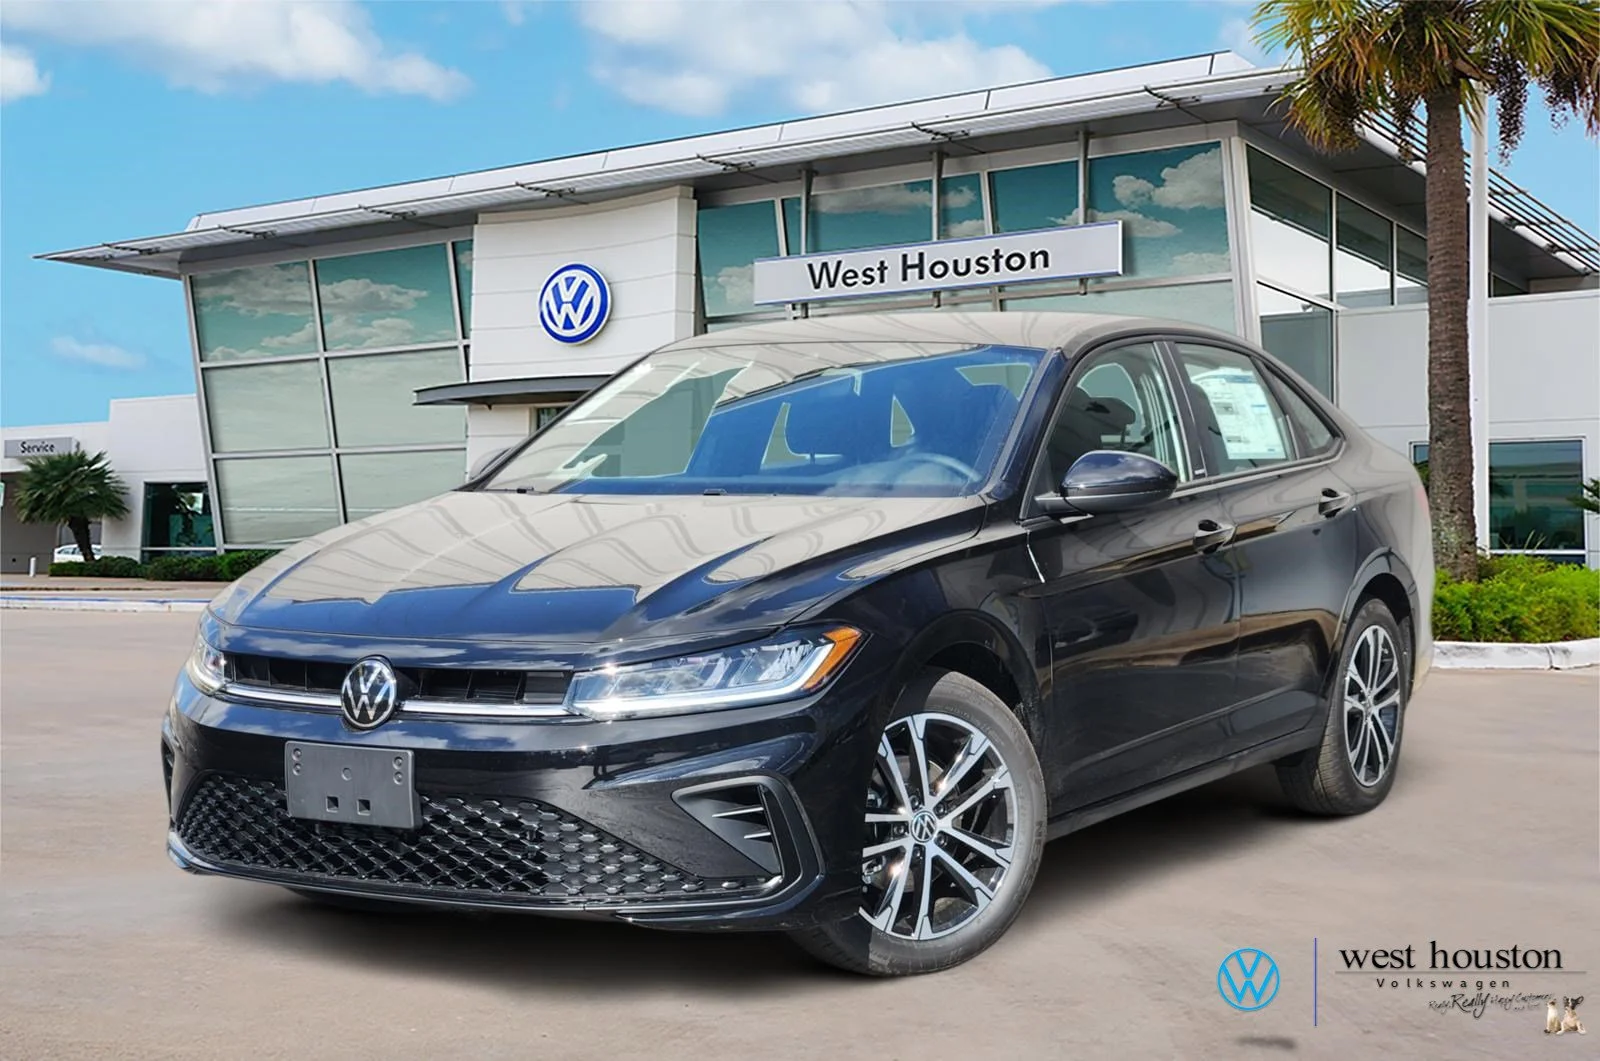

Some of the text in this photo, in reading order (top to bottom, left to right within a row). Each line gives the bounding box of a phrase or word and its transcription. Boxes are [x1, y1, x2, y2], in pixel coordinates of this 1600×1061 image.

[807, 248, 1050, 290] West Houston
[20, 441, 55, 454] Service
